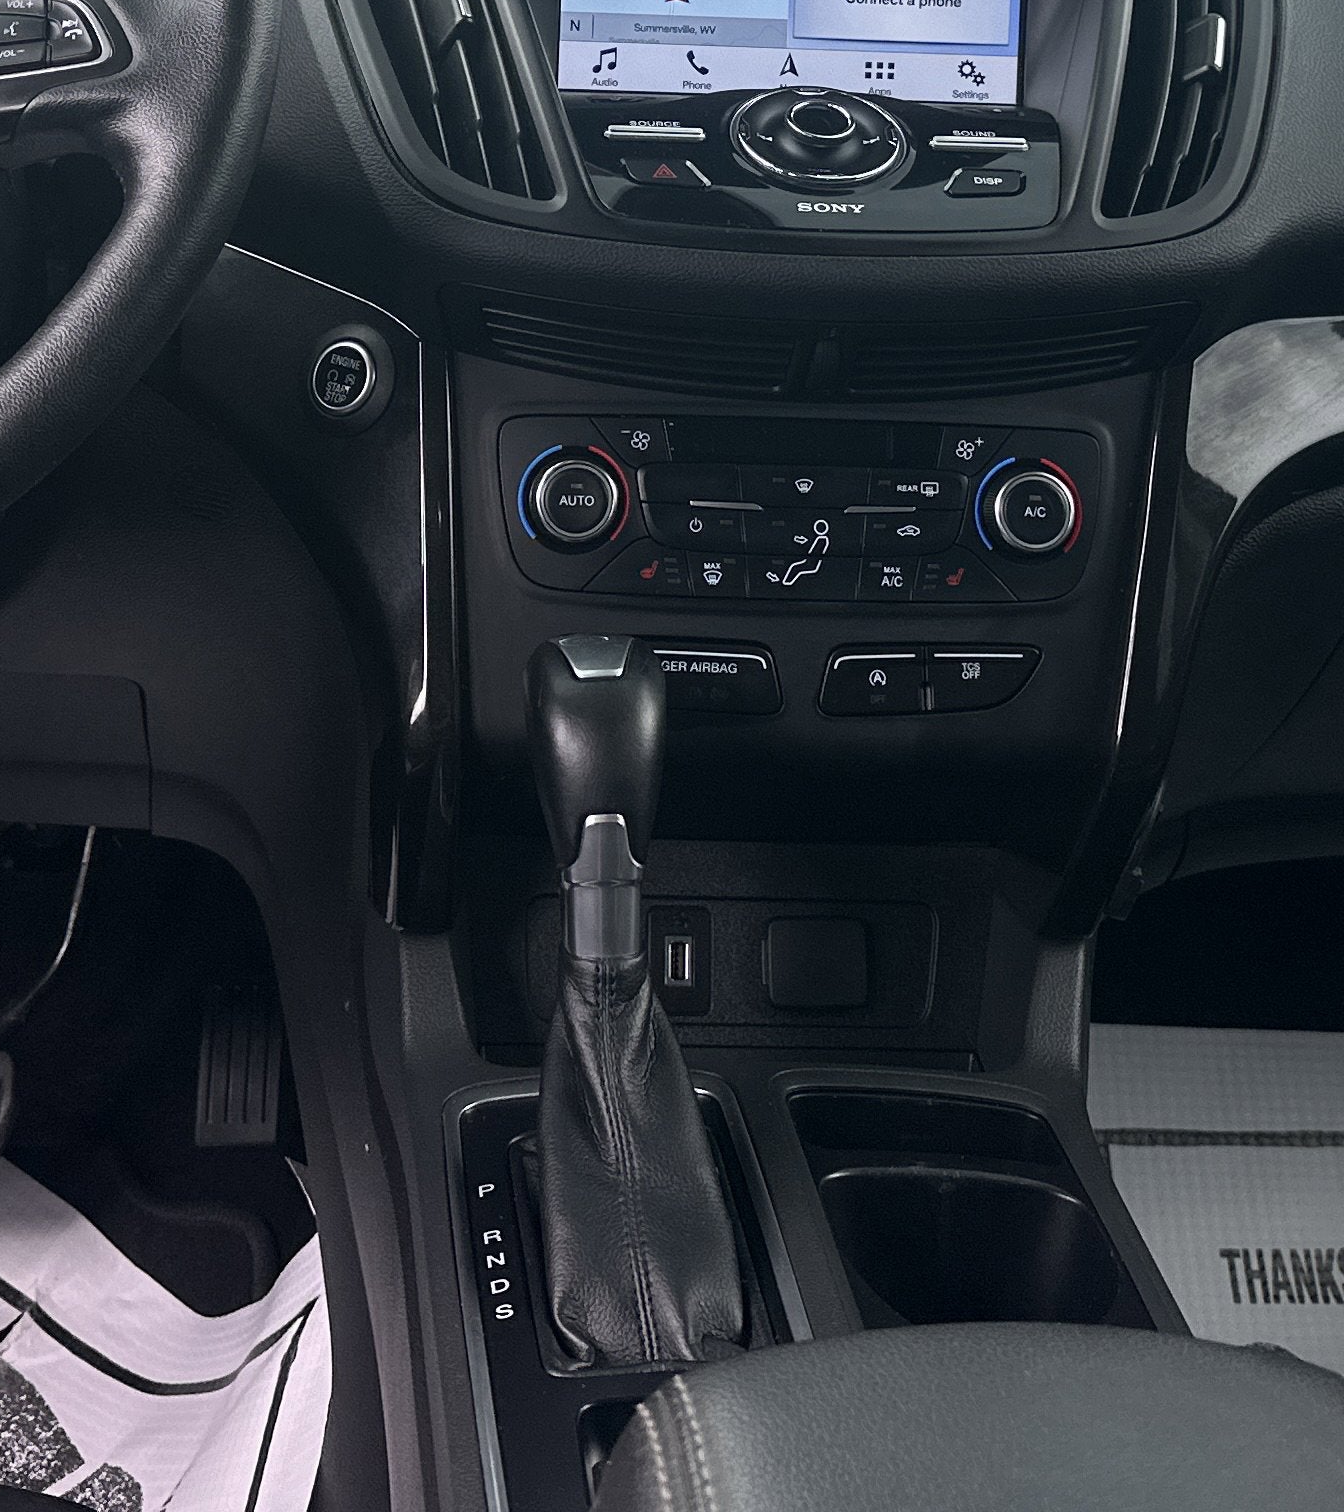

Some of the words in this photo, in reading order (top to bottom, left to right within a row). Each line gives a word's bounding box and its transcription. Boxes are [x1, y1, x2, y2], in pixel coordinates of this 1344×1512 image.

[570, 19, 581, 32] N
[633, 23, 698, 36] Summersville,
[700, 25, 717, 35] WV
[591, 77, 619, 87] Audio
[682, 80, 712, 90] Phone
[952, 89, 990, 100] Settings
[952, 129, 997, 137] SOUND
[973, 176, 1003, 186] DISP
[796, 201, 865, 214] SONY
[331, 354, 361, 370] ENGINE
[325, 381, 351, 394] START
[324, 391, 347, 403] STOP
[559, 495, 595, 507] AUTO
[1024, 507, 1047, 518] A/C
[703, 562, 722, 570] MAX
[883, 566, 901, 574] MAX
[881, 575, 904, 588] A/C
[661, 660, 687, 672] GER
[689, 662, 738, 674] AIRBAG
[961, 662, 981, 671] TCS
[961, 671, 981, 679] OFF
[478, 1183, 495, 1198] P
[483, 1229, 502, 1245] R
[486, 1252, 506, 1269] N
[490, 1278, 510, 1294] D
[495, 1303, 514, 1320] S
